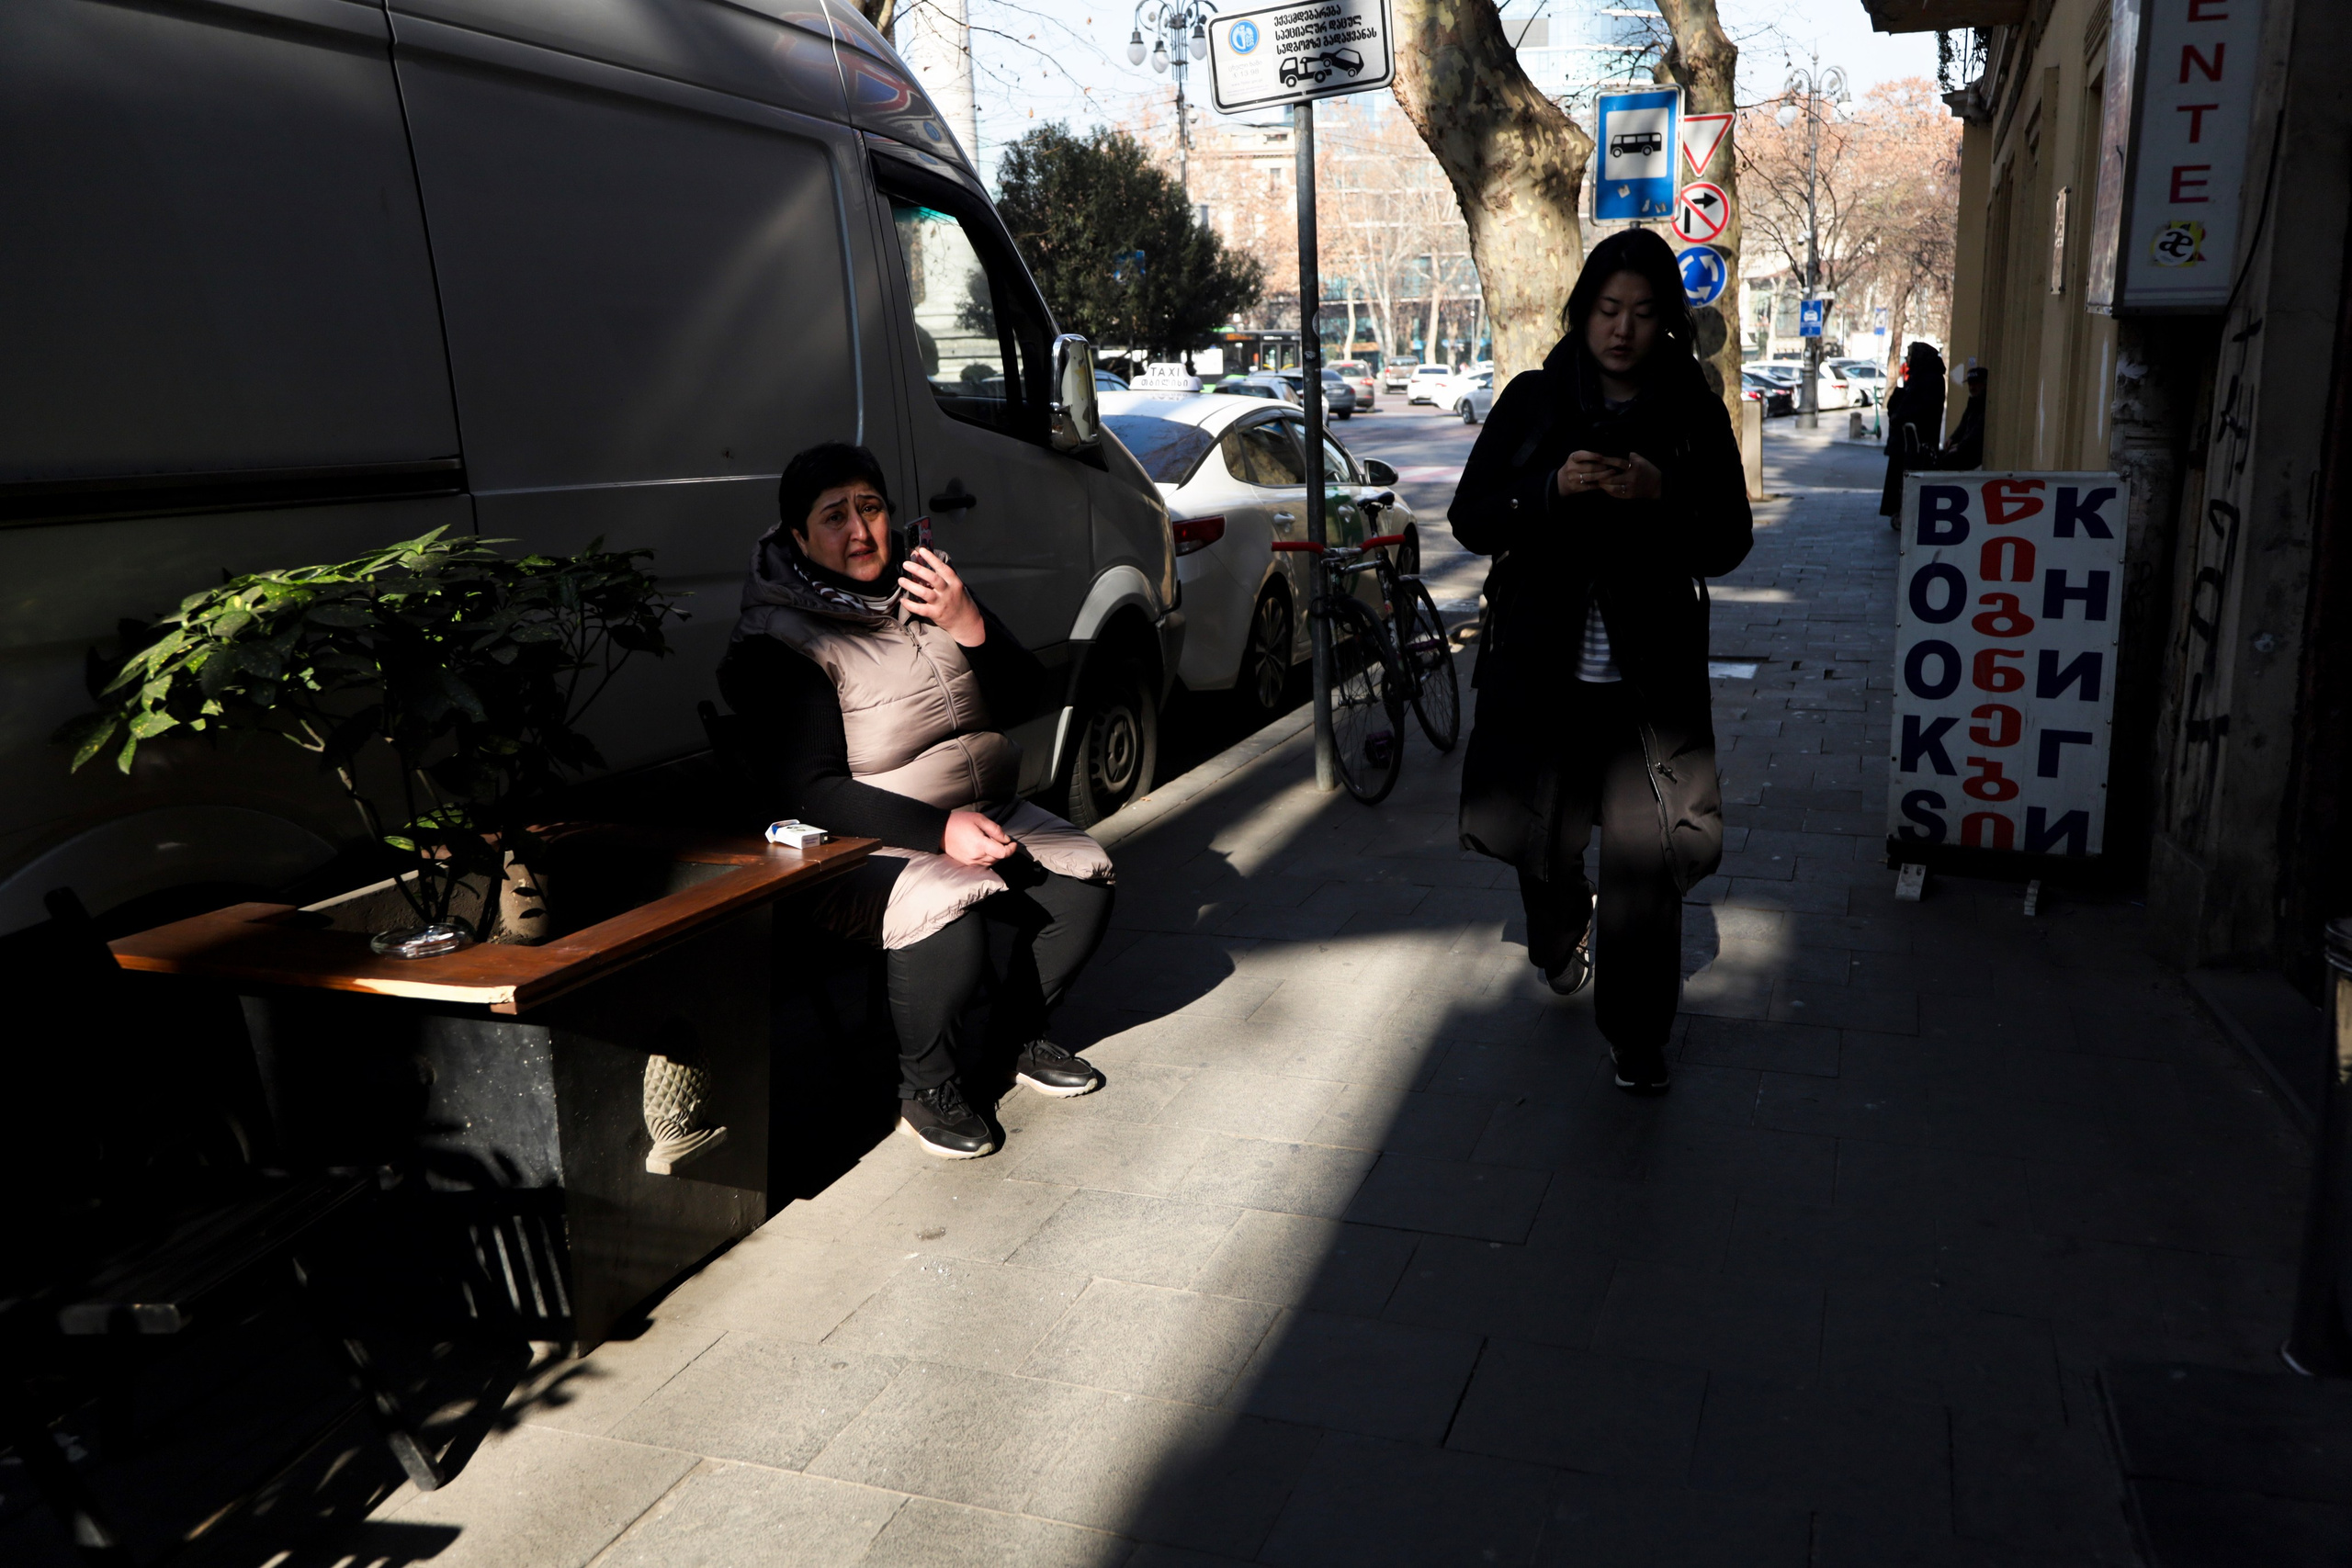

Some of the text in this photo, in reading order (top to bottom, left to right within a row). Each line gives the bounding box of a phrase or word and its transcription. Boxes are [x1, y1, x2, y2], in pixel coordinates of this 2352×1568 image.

[1274, 5, 1341, 27] ექვემდებარება
[1275, 15, 1362, 40] სპეციალურ დაცულ
[1277, 27, 1377, 54] სადგომზე გადაყვანას
[2166, 0, 2229, 261] ENTE
[1151, 367, 1180, 377] TAXI
[1897, 485, 1970, 845] BOOKS
[1961, 479, 2046, 849] წიგნები
[2024, 487, 2117, 856] КНИГИ
